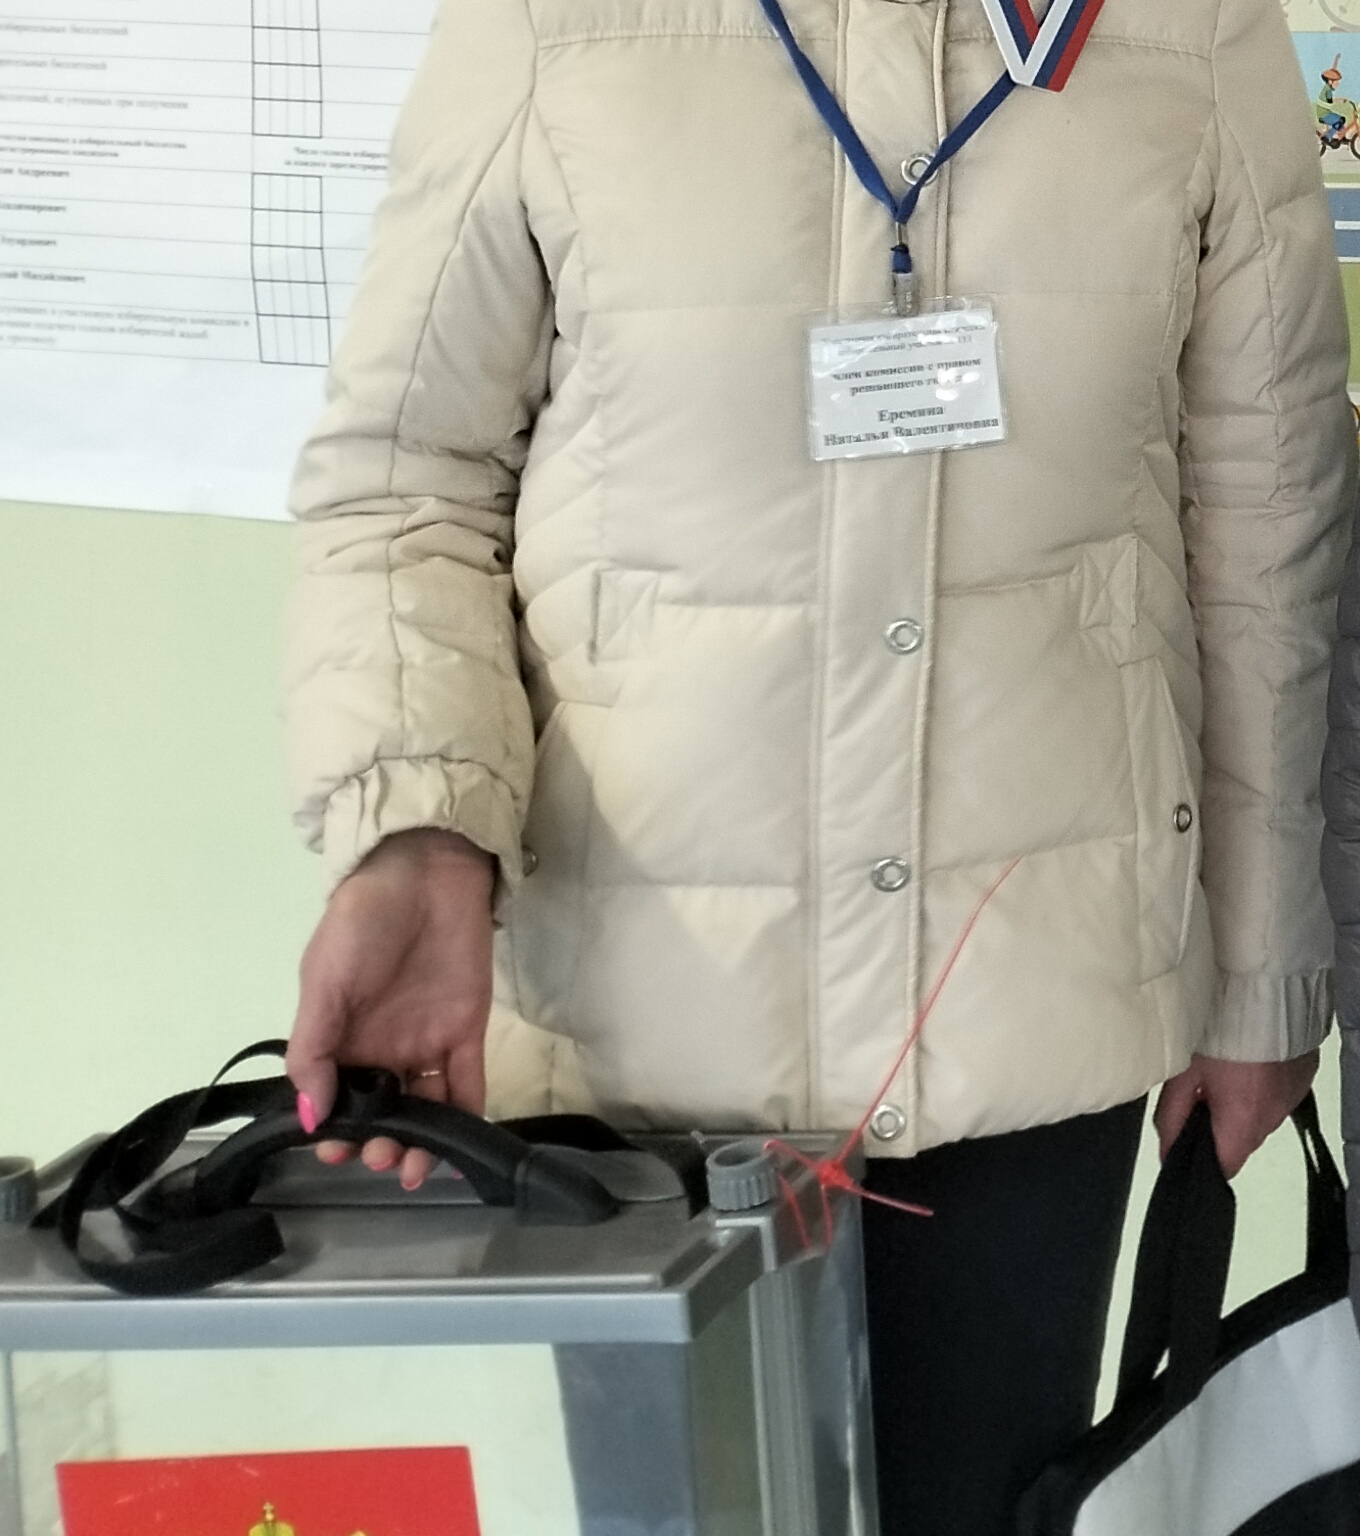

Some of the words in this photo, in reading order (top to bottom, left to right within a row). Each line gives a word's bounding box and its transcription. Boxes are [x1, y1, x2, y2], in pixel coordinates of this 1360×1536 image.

[865, 365, 925, 379] комиссии
[877, 405, 944, 424] Еремина
[823, 429, 889, 447] Наталья
[892, 416, 999, 439] Валентиновна
